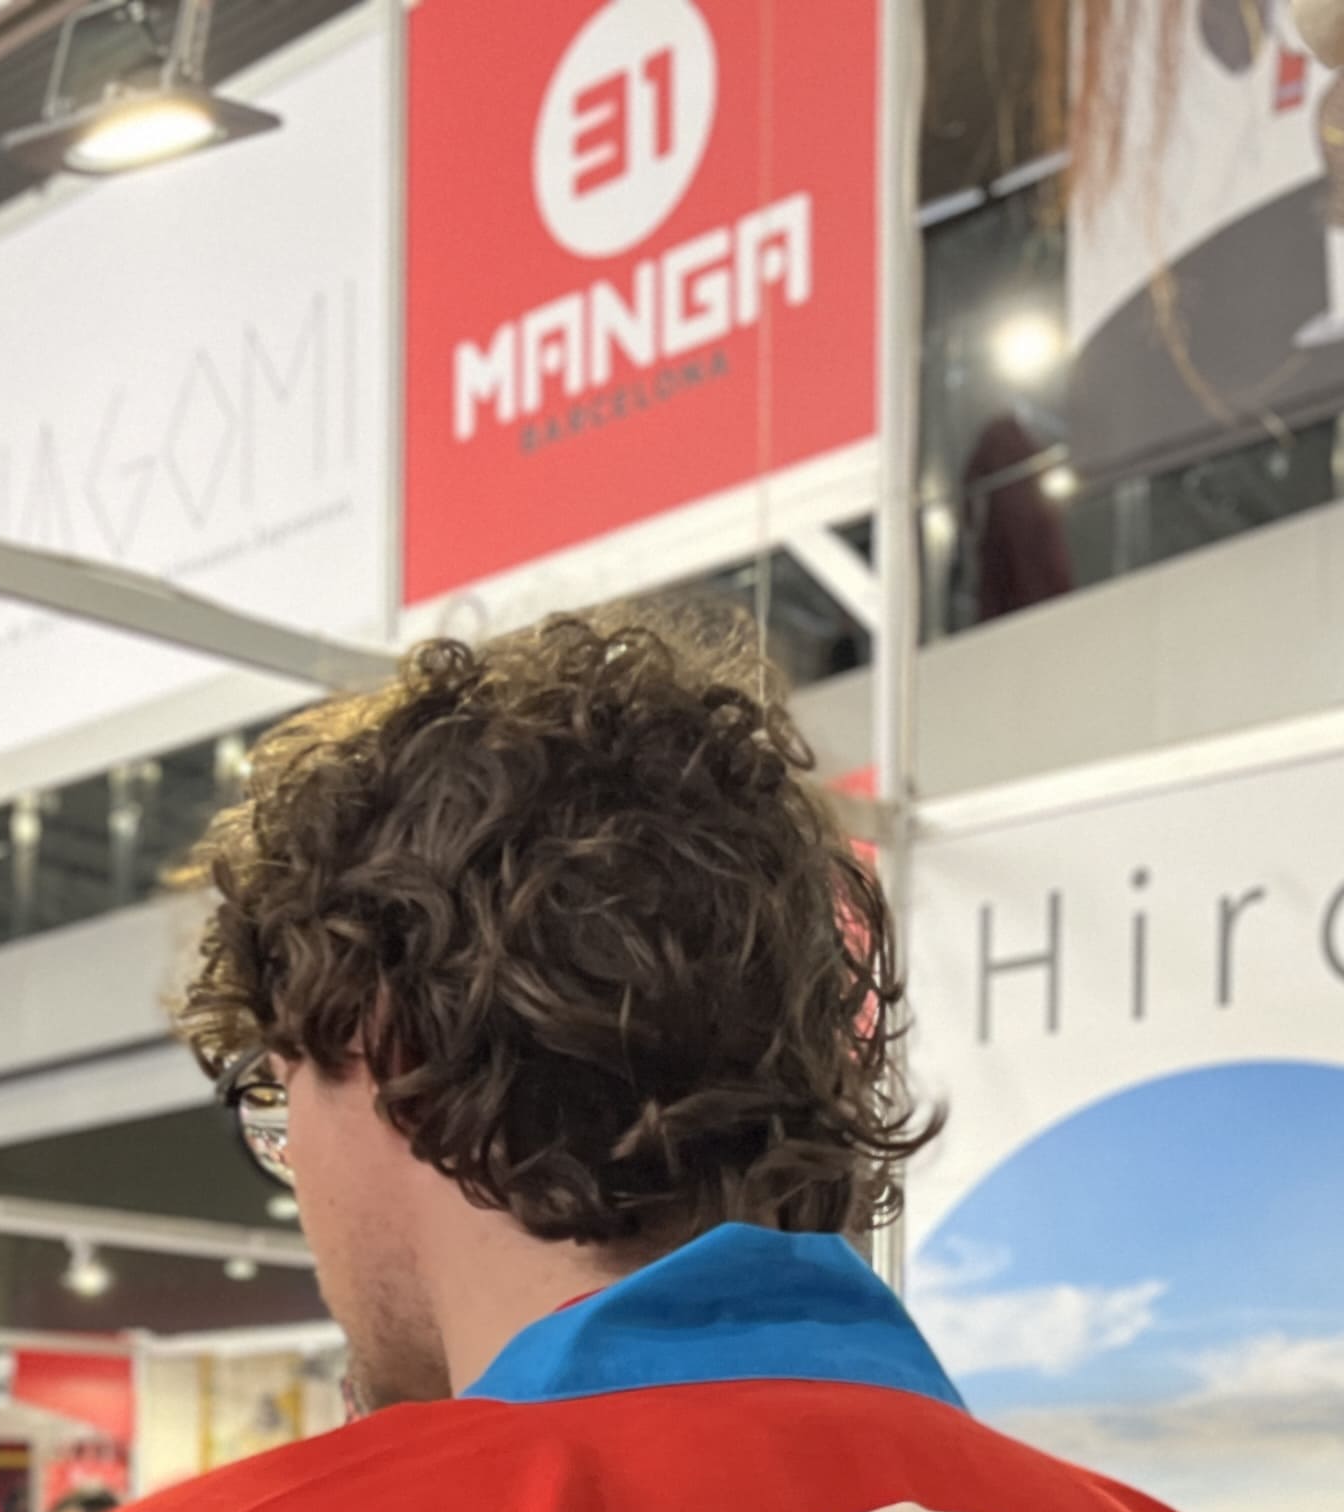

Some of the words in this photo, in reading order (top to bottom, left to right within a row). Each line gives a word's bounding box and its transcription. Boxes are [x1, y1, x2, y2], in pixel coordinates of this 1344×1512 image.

[570, 45, 674, 201] 31
[453, 191, 812, 442] MANGA
[518, 348, 732, 456] BARCELONA
